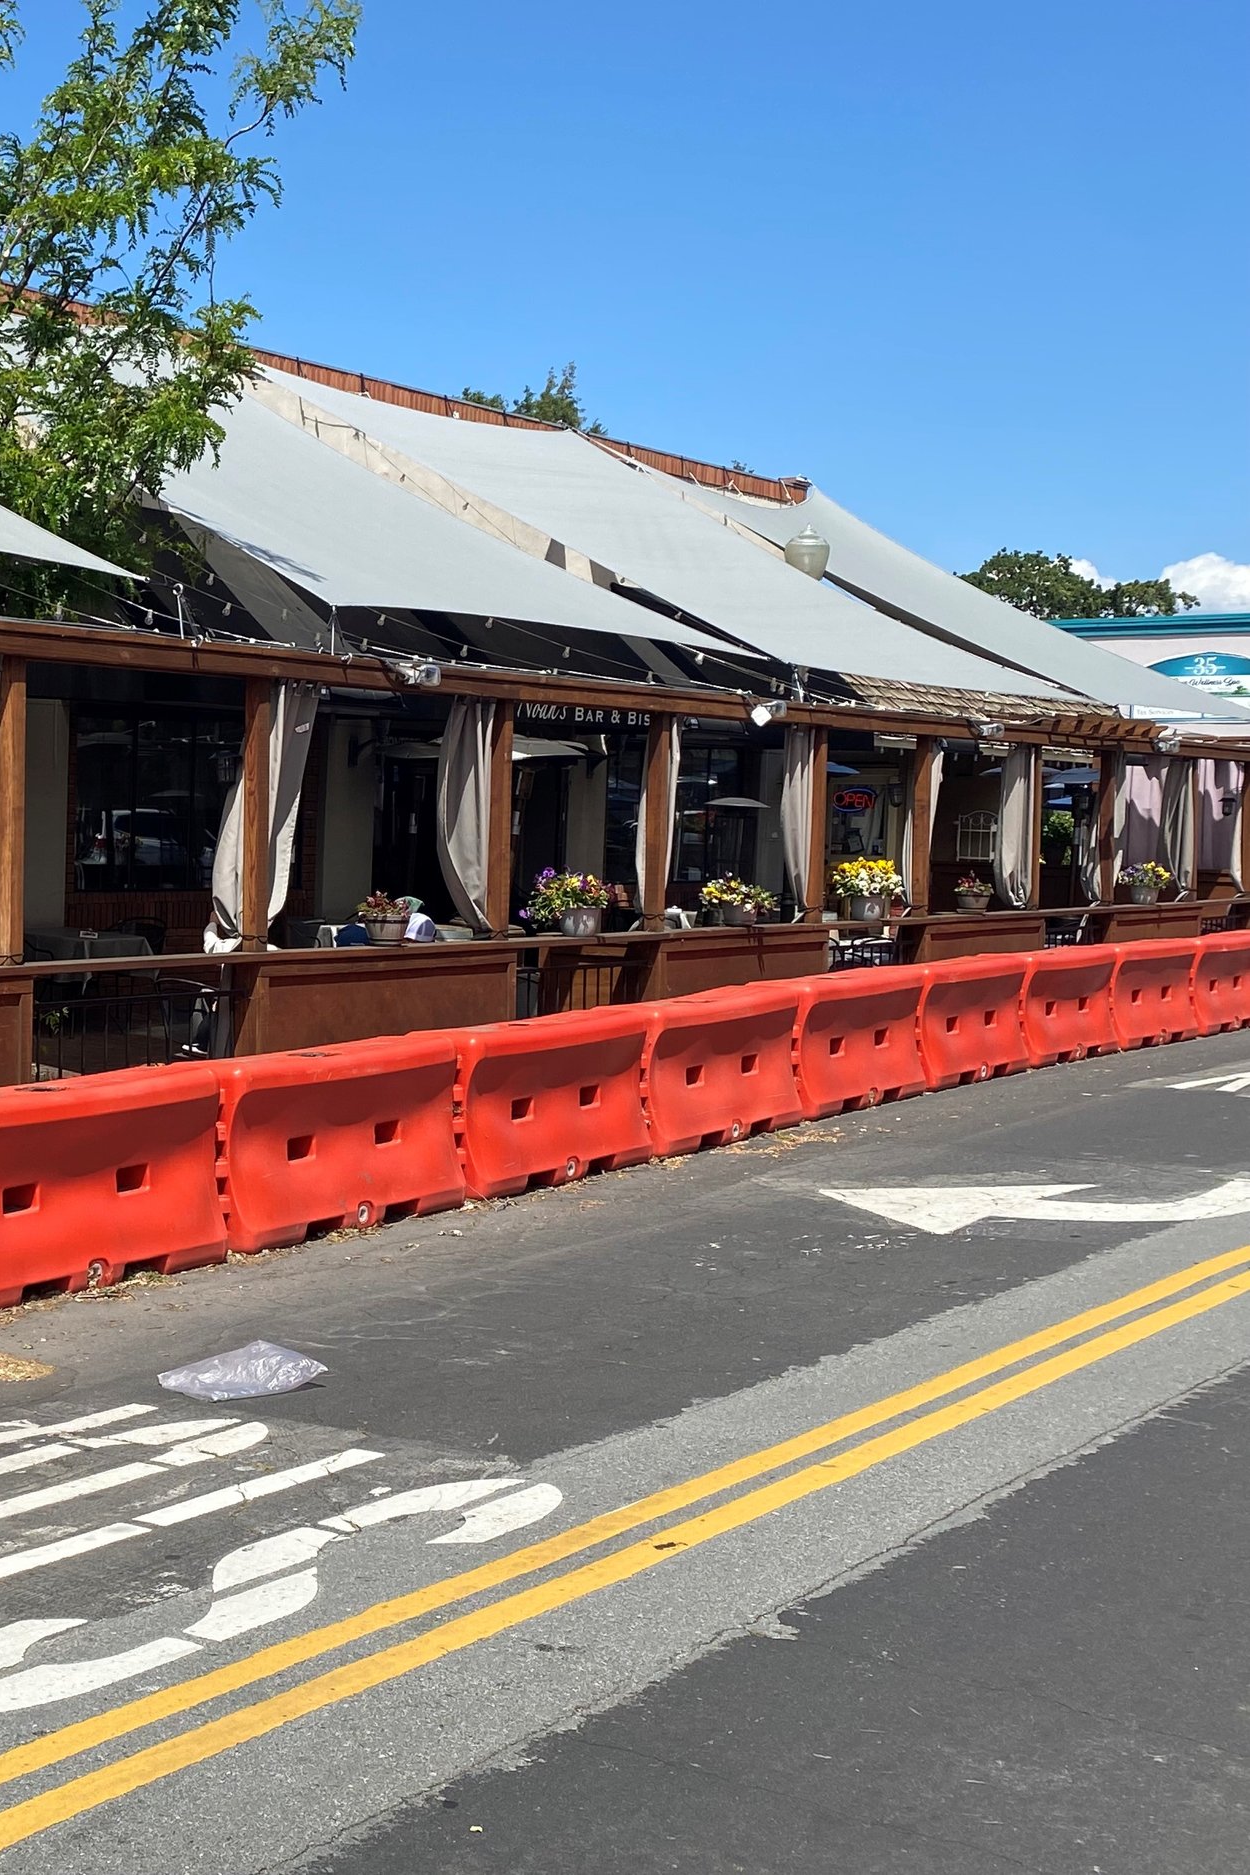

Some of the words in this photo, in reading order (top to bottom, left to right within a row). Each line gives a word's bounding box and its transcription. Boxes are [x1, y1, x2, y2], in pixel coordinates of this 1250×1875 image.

[610, 710, 620, 724] &
[627, 712, 651, 726] BIS
[833, 791, 875, 809] OPEN
